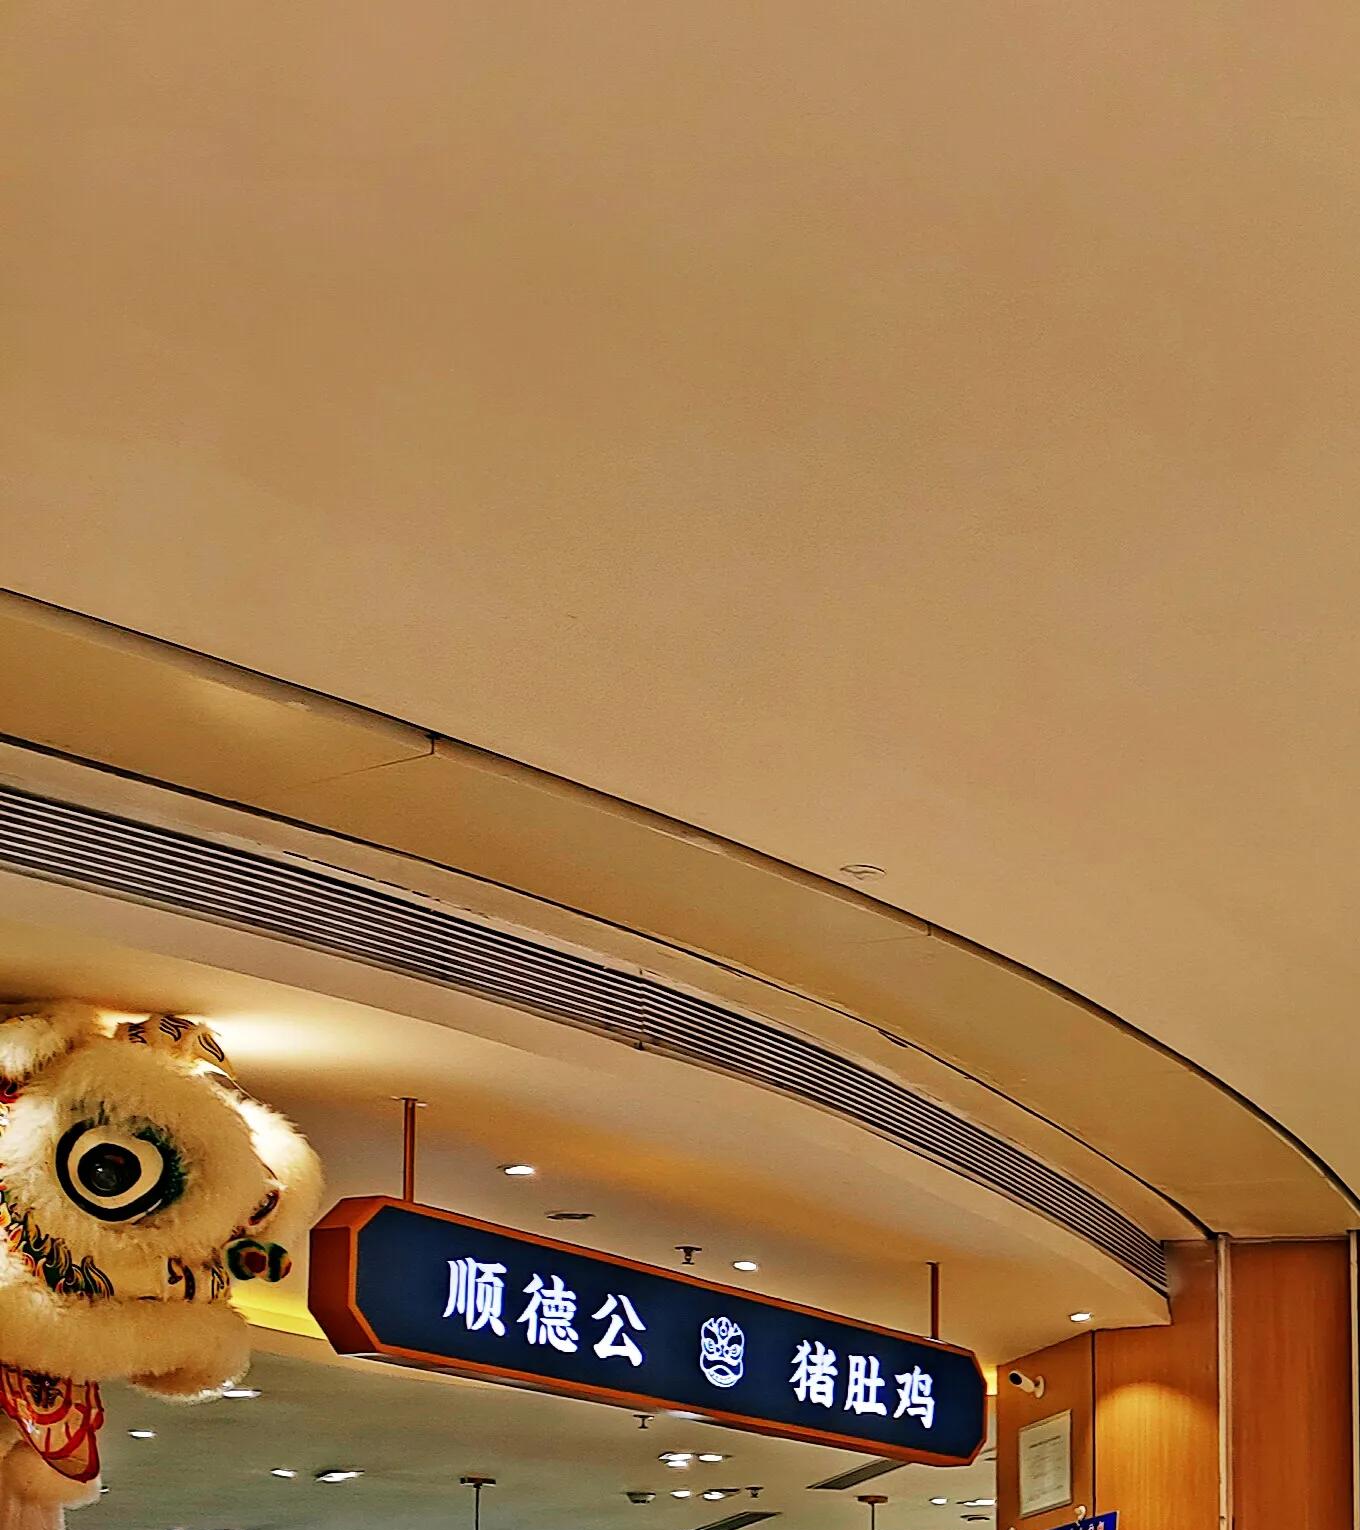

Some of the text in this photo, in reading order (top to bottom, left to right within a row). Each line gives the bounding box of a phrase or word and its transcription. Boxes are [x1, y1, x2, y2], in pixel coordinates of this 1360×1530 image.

[443, 1257, 935, 1428] 顺德公 猪肚鸡
